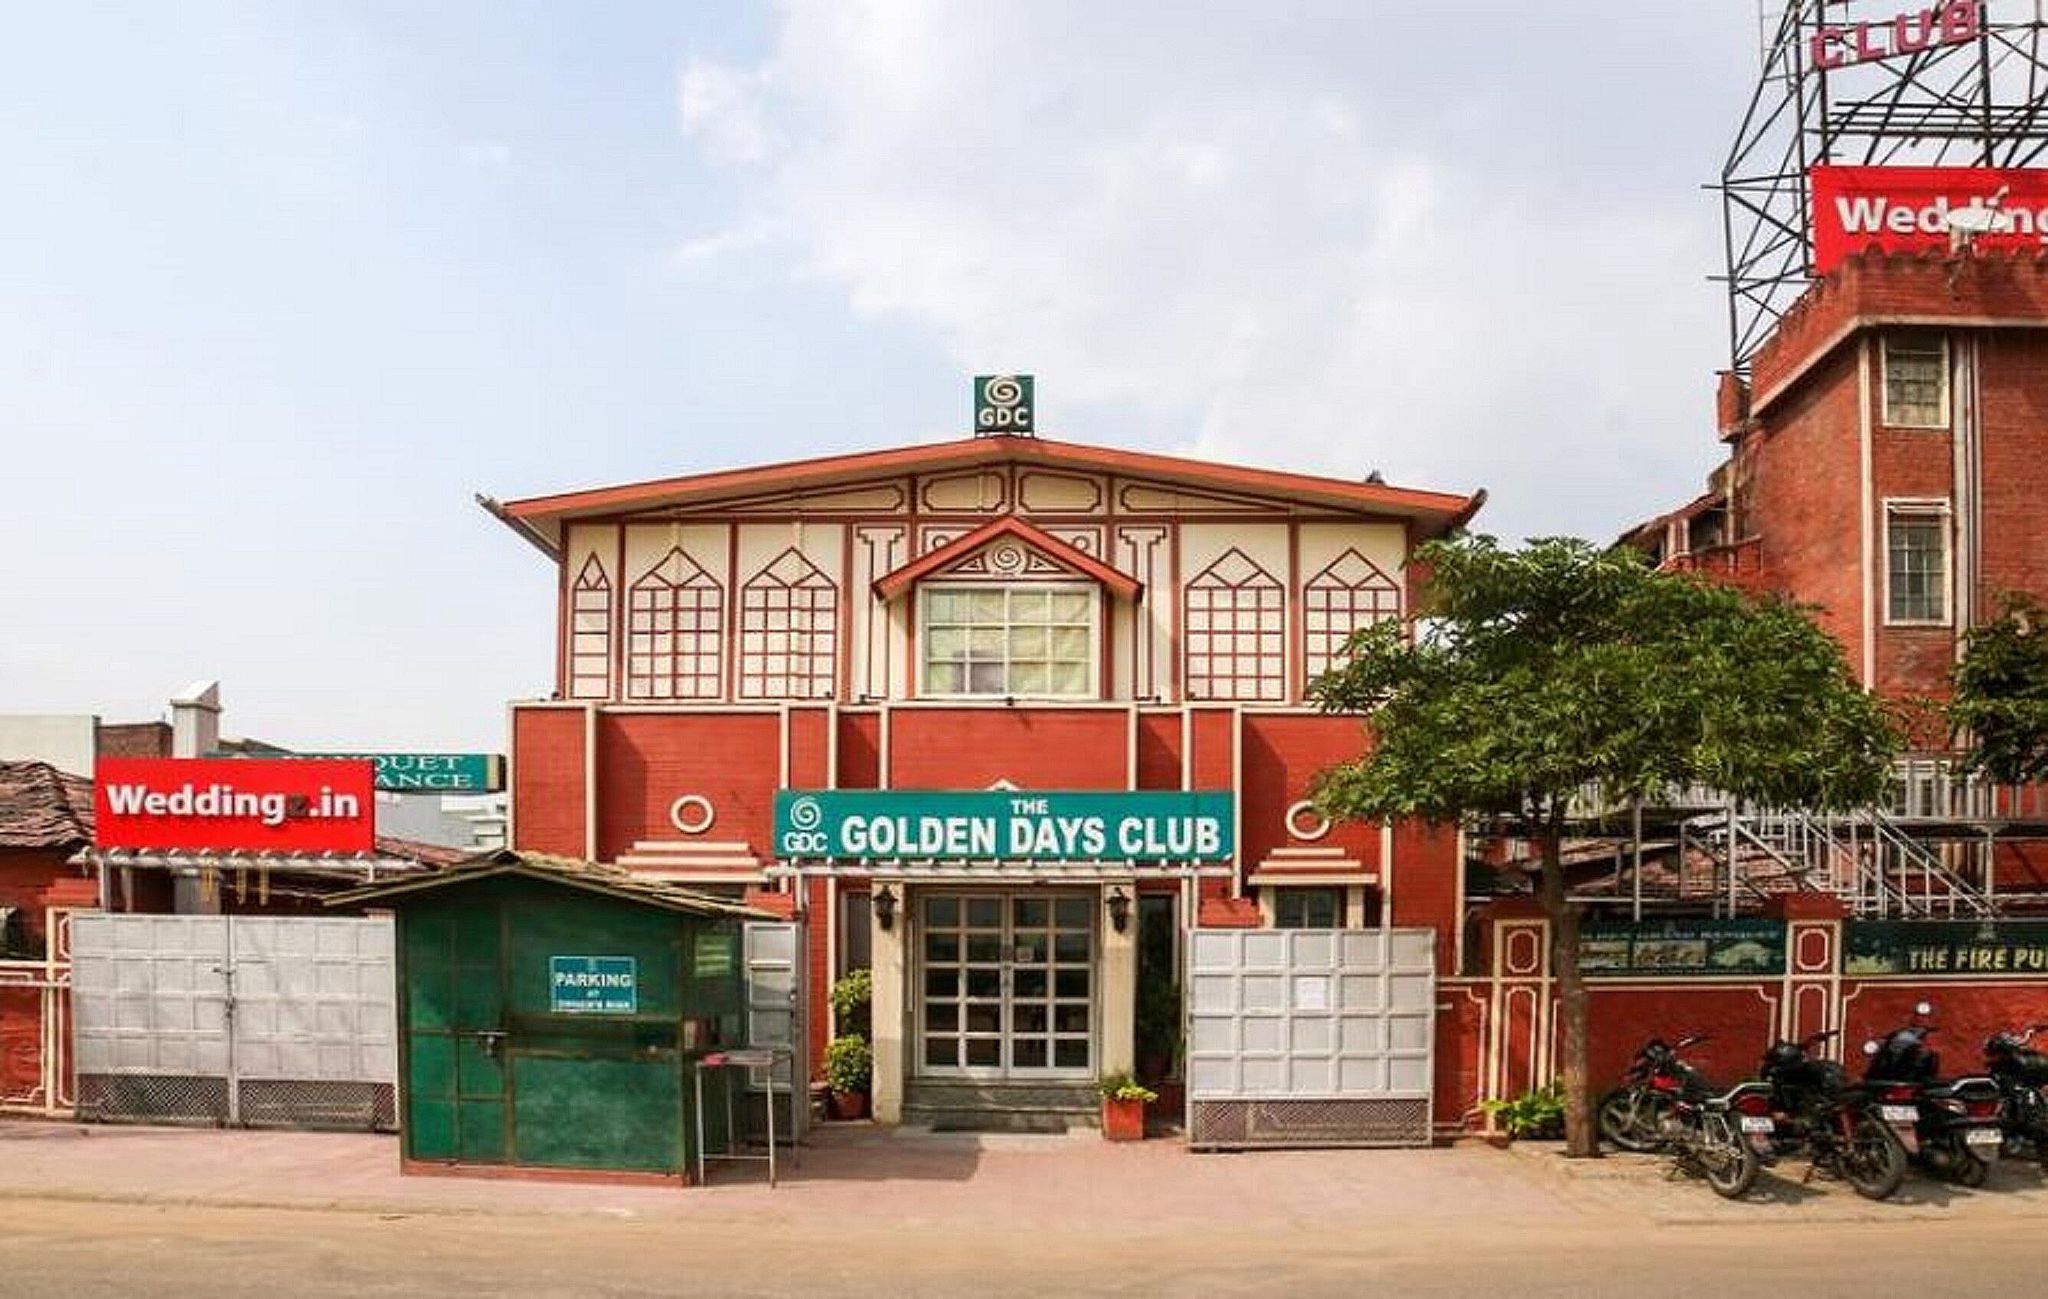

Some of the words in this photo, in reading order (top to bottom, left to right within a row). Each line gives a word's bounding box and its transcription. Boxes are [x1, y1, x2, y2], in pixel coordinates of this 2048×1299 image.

[1811, 0, 1976, 69] CLUB
[978, 407, 1029, 426] GDC
[1011, 799, 1049, 815] THE
[783, 832, 829, 852] GDC
[841, 815, 996, 854] GOLDEN
[1010, 816, 1106, 854] DAYS
[1118, 816, 1220, 854] CLUB
[1908, 946, 1949, 969] THE
[1955, 946, 2008, 969] FIRE
[2013, 947, 2048, 969] PU
[555, 972, 632, 987] PARKING
